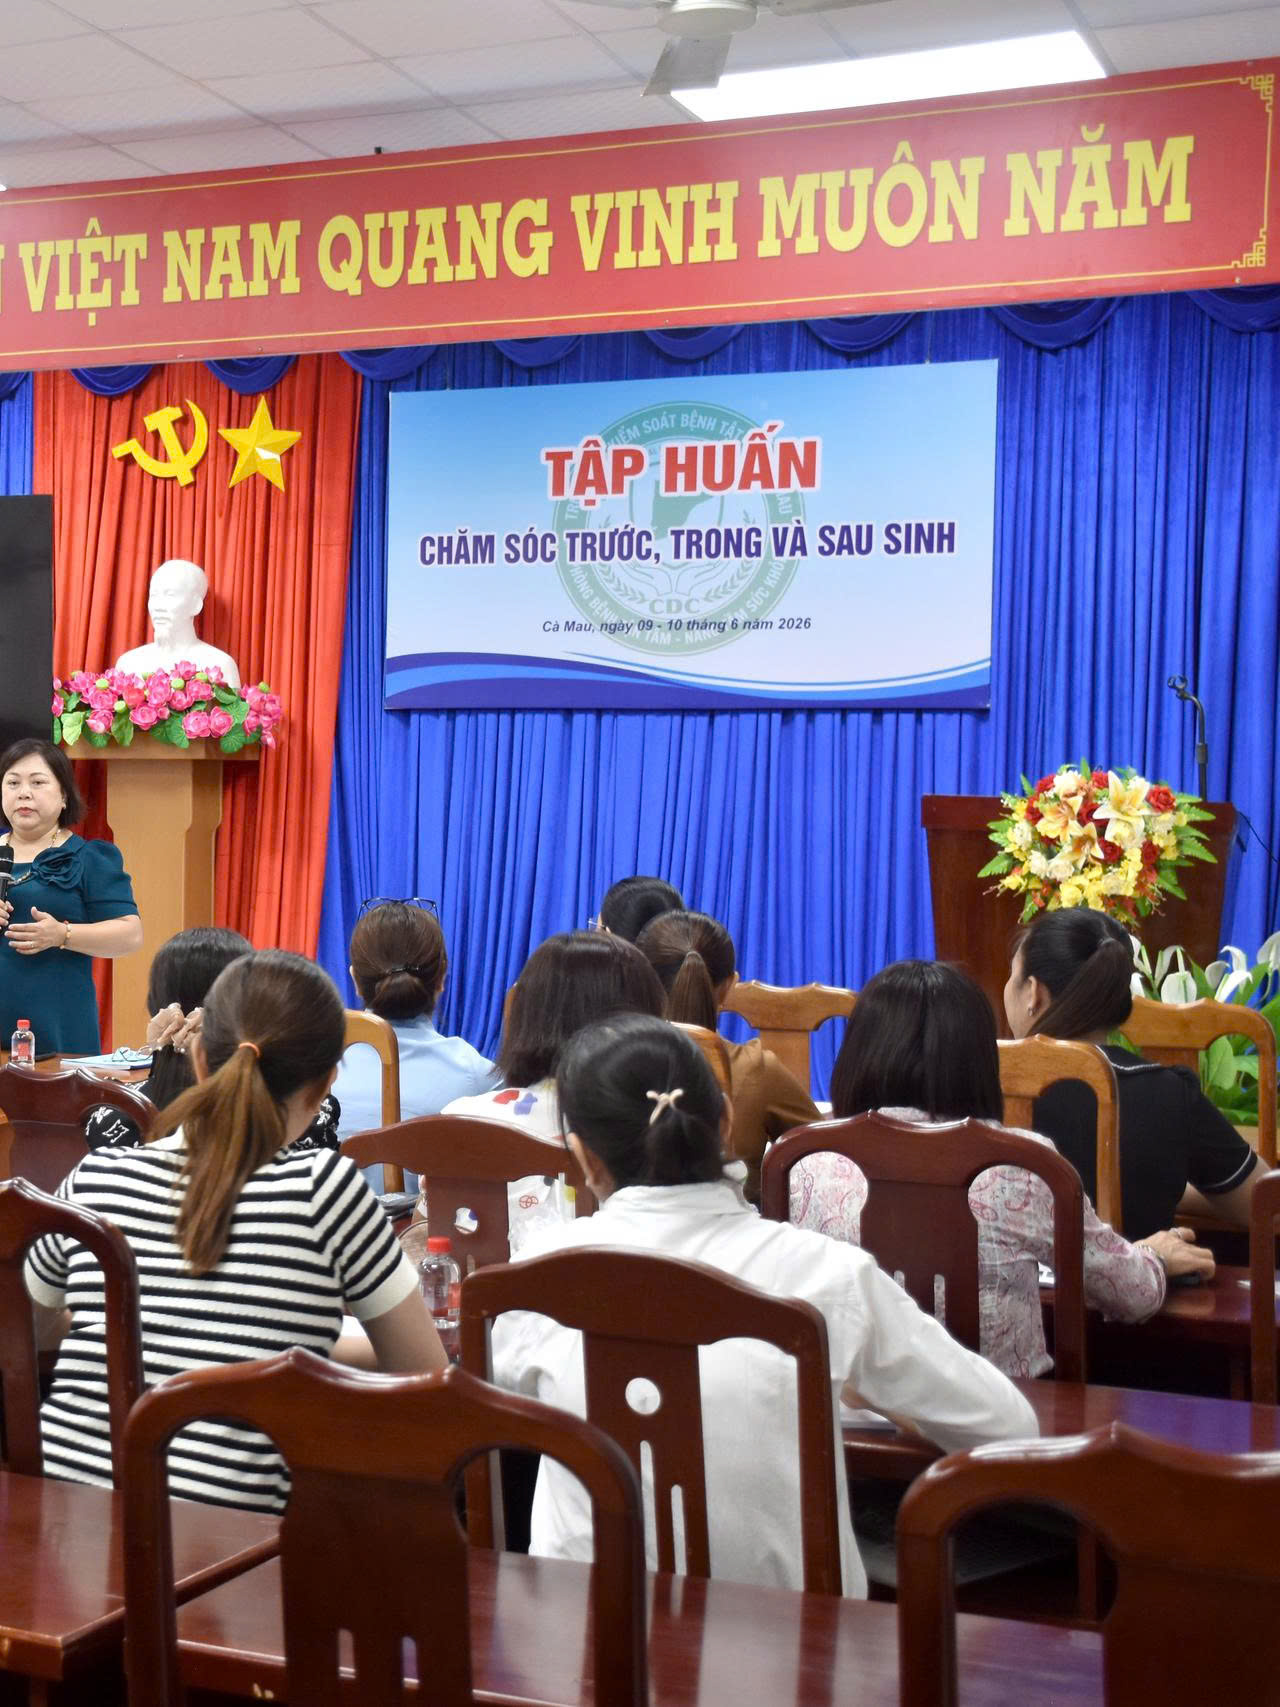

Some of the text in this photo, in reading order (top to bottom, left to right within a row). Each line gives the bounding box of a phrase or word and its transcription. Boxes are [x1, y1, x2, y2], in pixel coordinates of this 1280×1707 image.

[19, 217, 147, 326] VIỆT
[162, 220, 301, 303] NAM
[317, 198, 553, 296] QUANG
[570, 180, 739, 272] VINH
[757, 140, 986, 258] MUÔN
[1004, 123, 1195, 237] NĂM
[641, 411, 677, 434] SOÁT
[681, 409, 717, 431] BỆNH
[545, 424, 817, 507] TẬP HUẤN
[420, 519, 955, 566] CHĂM SÓC TRƯỚC, TRONG VÀ SAU SINH
[649, 598, 700, 615] CDC
[542, 620, 559, 633] Cà
[564, 620, 595, 634] Mau,
[600, 619, 633, 635] ngày
[637, 619, 653, 632] 09
[667, 619, 683, 631] 10
[686, 618, 726, 633] tháng
[730, 618, 738, 630] 6
[742, 618, 773, 630] năm
[778, 617, 811, 630] 2026
